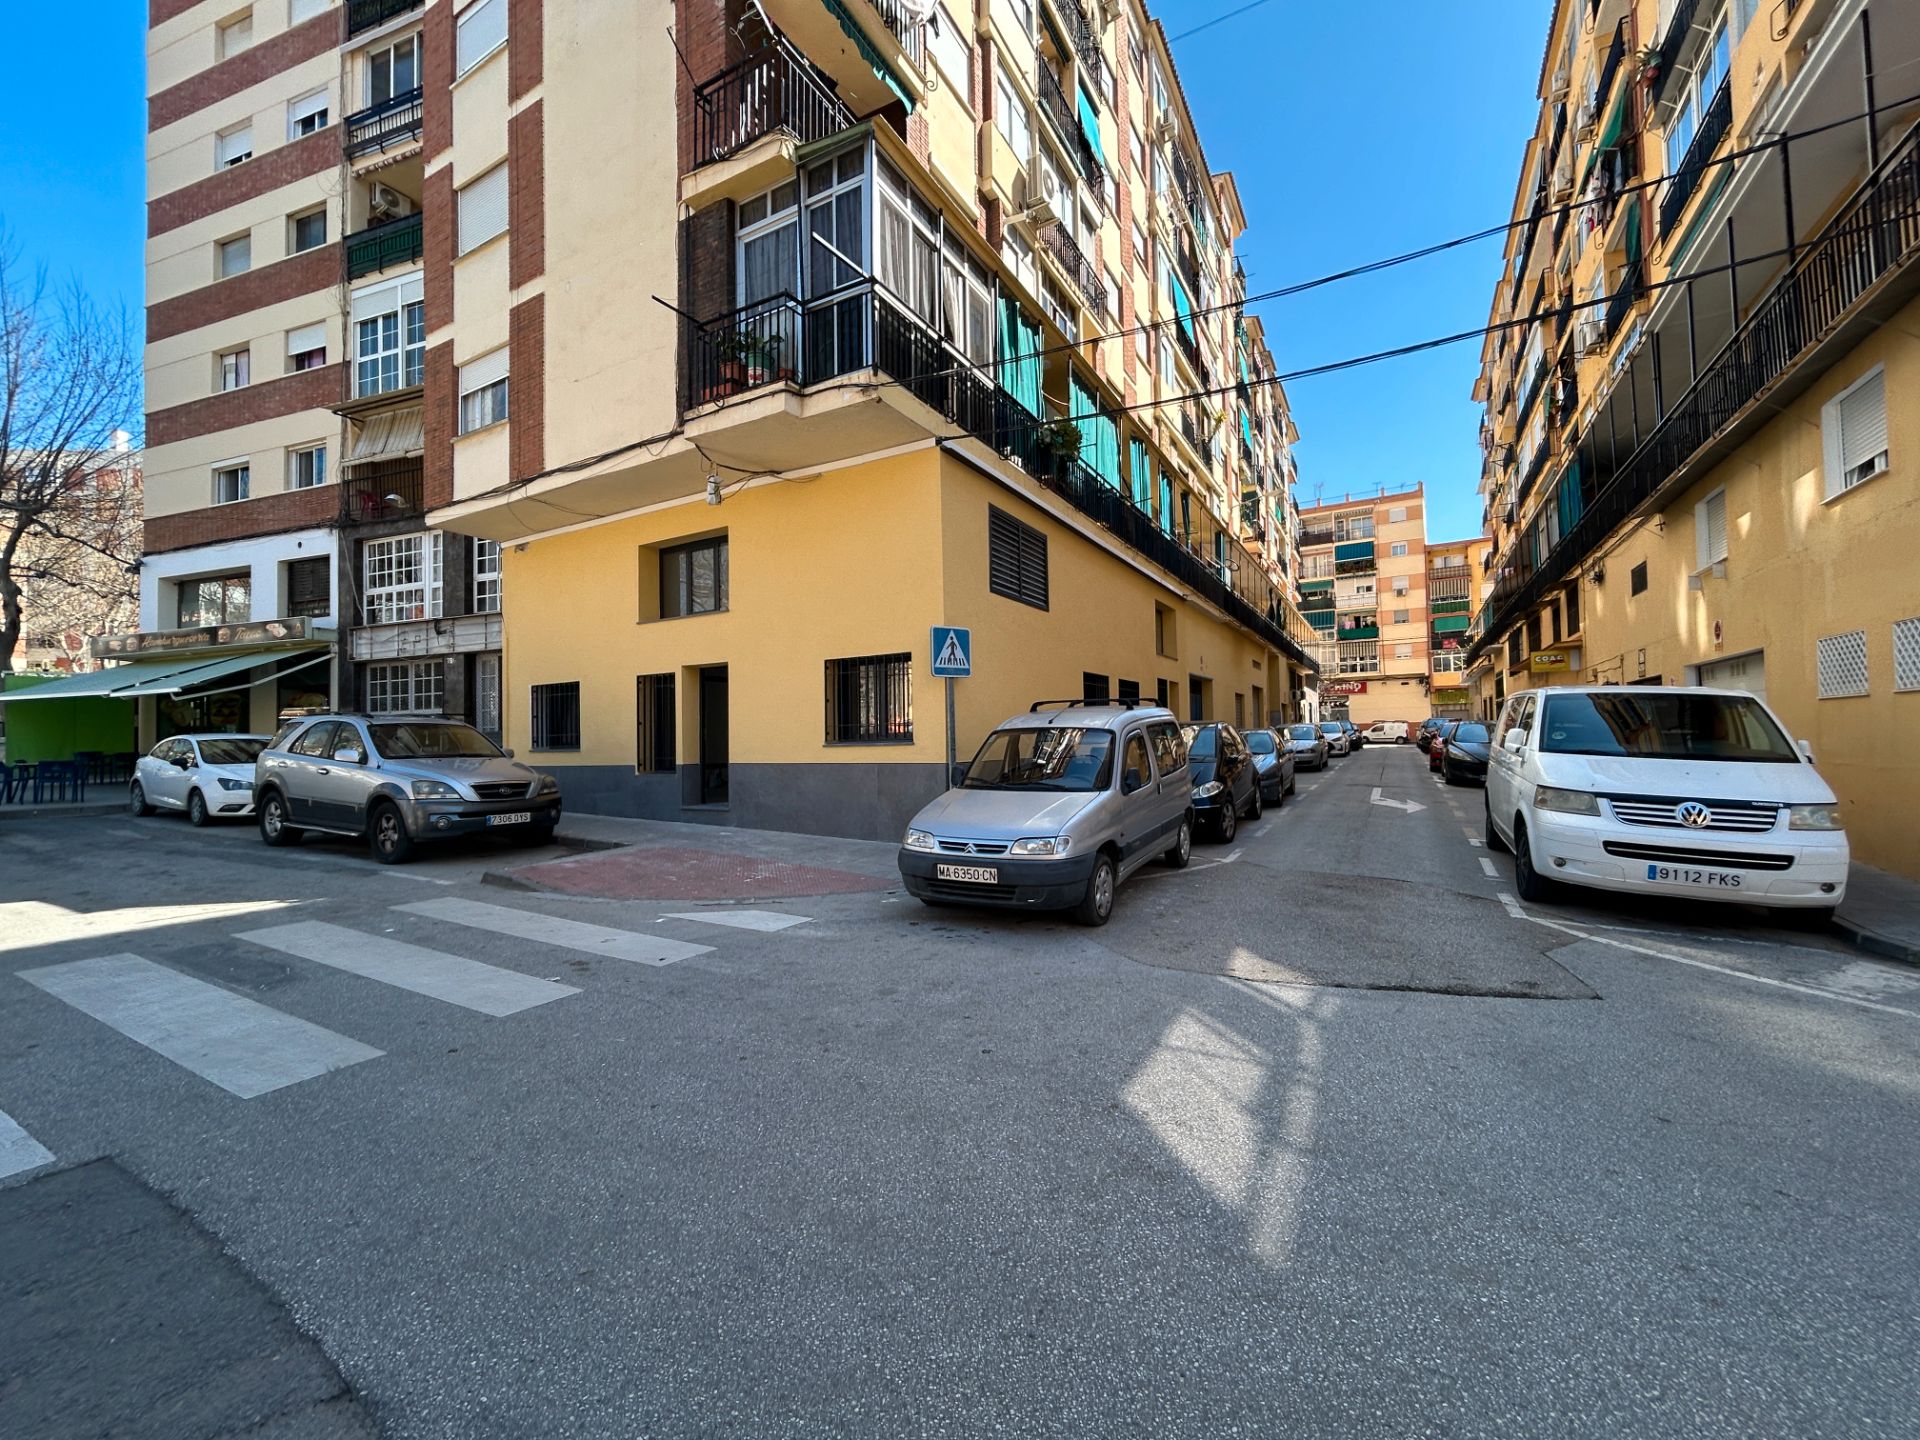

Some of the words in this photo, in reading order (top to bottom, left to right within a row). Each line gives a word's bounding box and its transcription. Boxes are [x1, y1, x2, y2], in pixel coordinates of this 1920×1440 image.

[491, 815, 513, 824] 7306
[1659, 867, 1702, 884] 9112
[1708, 873, 1741, 887] FKS
